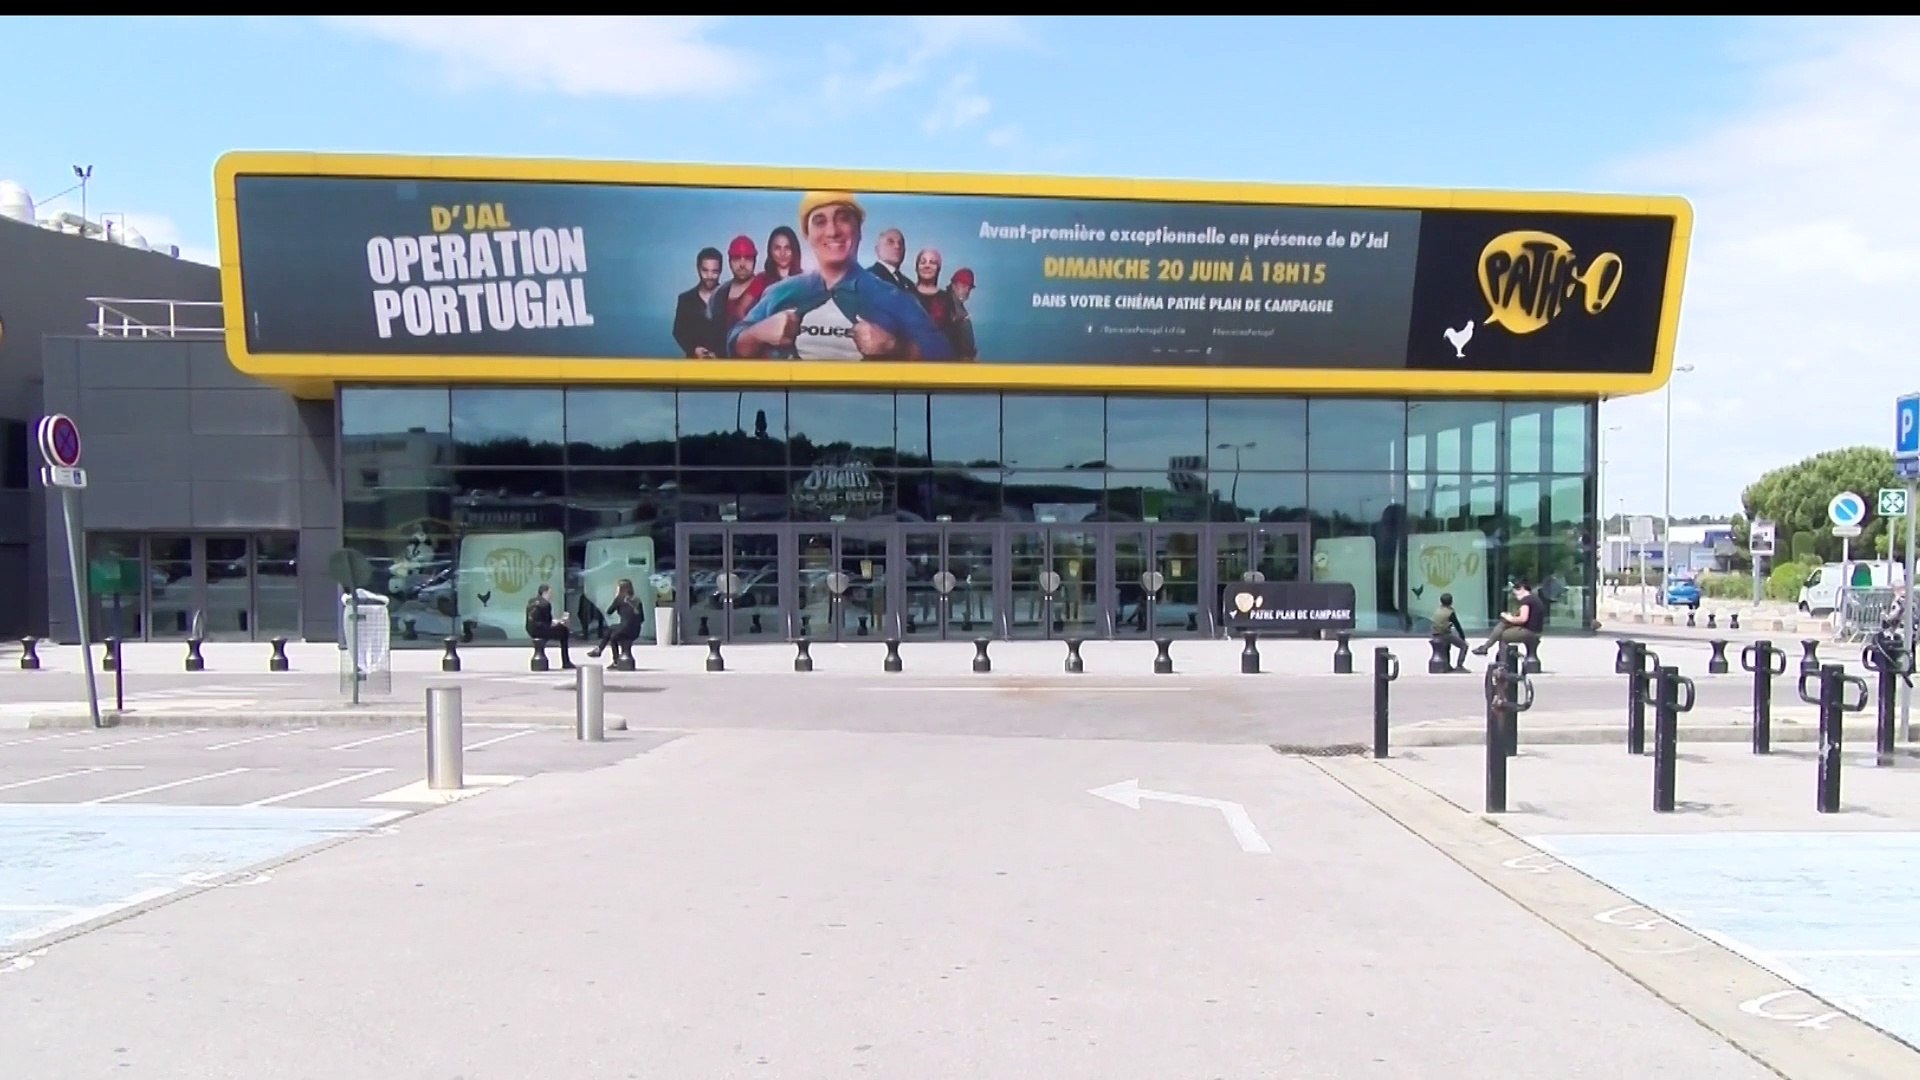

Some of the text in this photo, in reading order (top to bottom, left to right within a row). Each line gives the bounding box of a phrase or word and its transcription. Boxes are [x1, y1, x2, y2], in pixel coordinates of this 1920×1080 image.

[431, 203, 511, 232] D'JAL
[980, 221, 1389, 249] Avant-première exceptionnelle en présence de D'Jal
[366, 226, 587, 284] OPERATION
[1044, 256, 1327, 285] DIMANCHE 20 JUIN À 18H15
[373, 278, 594, 338] PORTUGAL
[1032, 292, 1334, 313] DANS VOTRE CINÉMA PATHÉ PLAN DE CAMPAGNE
[1902, 408, 1913, 444] P
[1275, 609, 1296, 620] PLAN
[1297, 609, 1308, 620] DE
